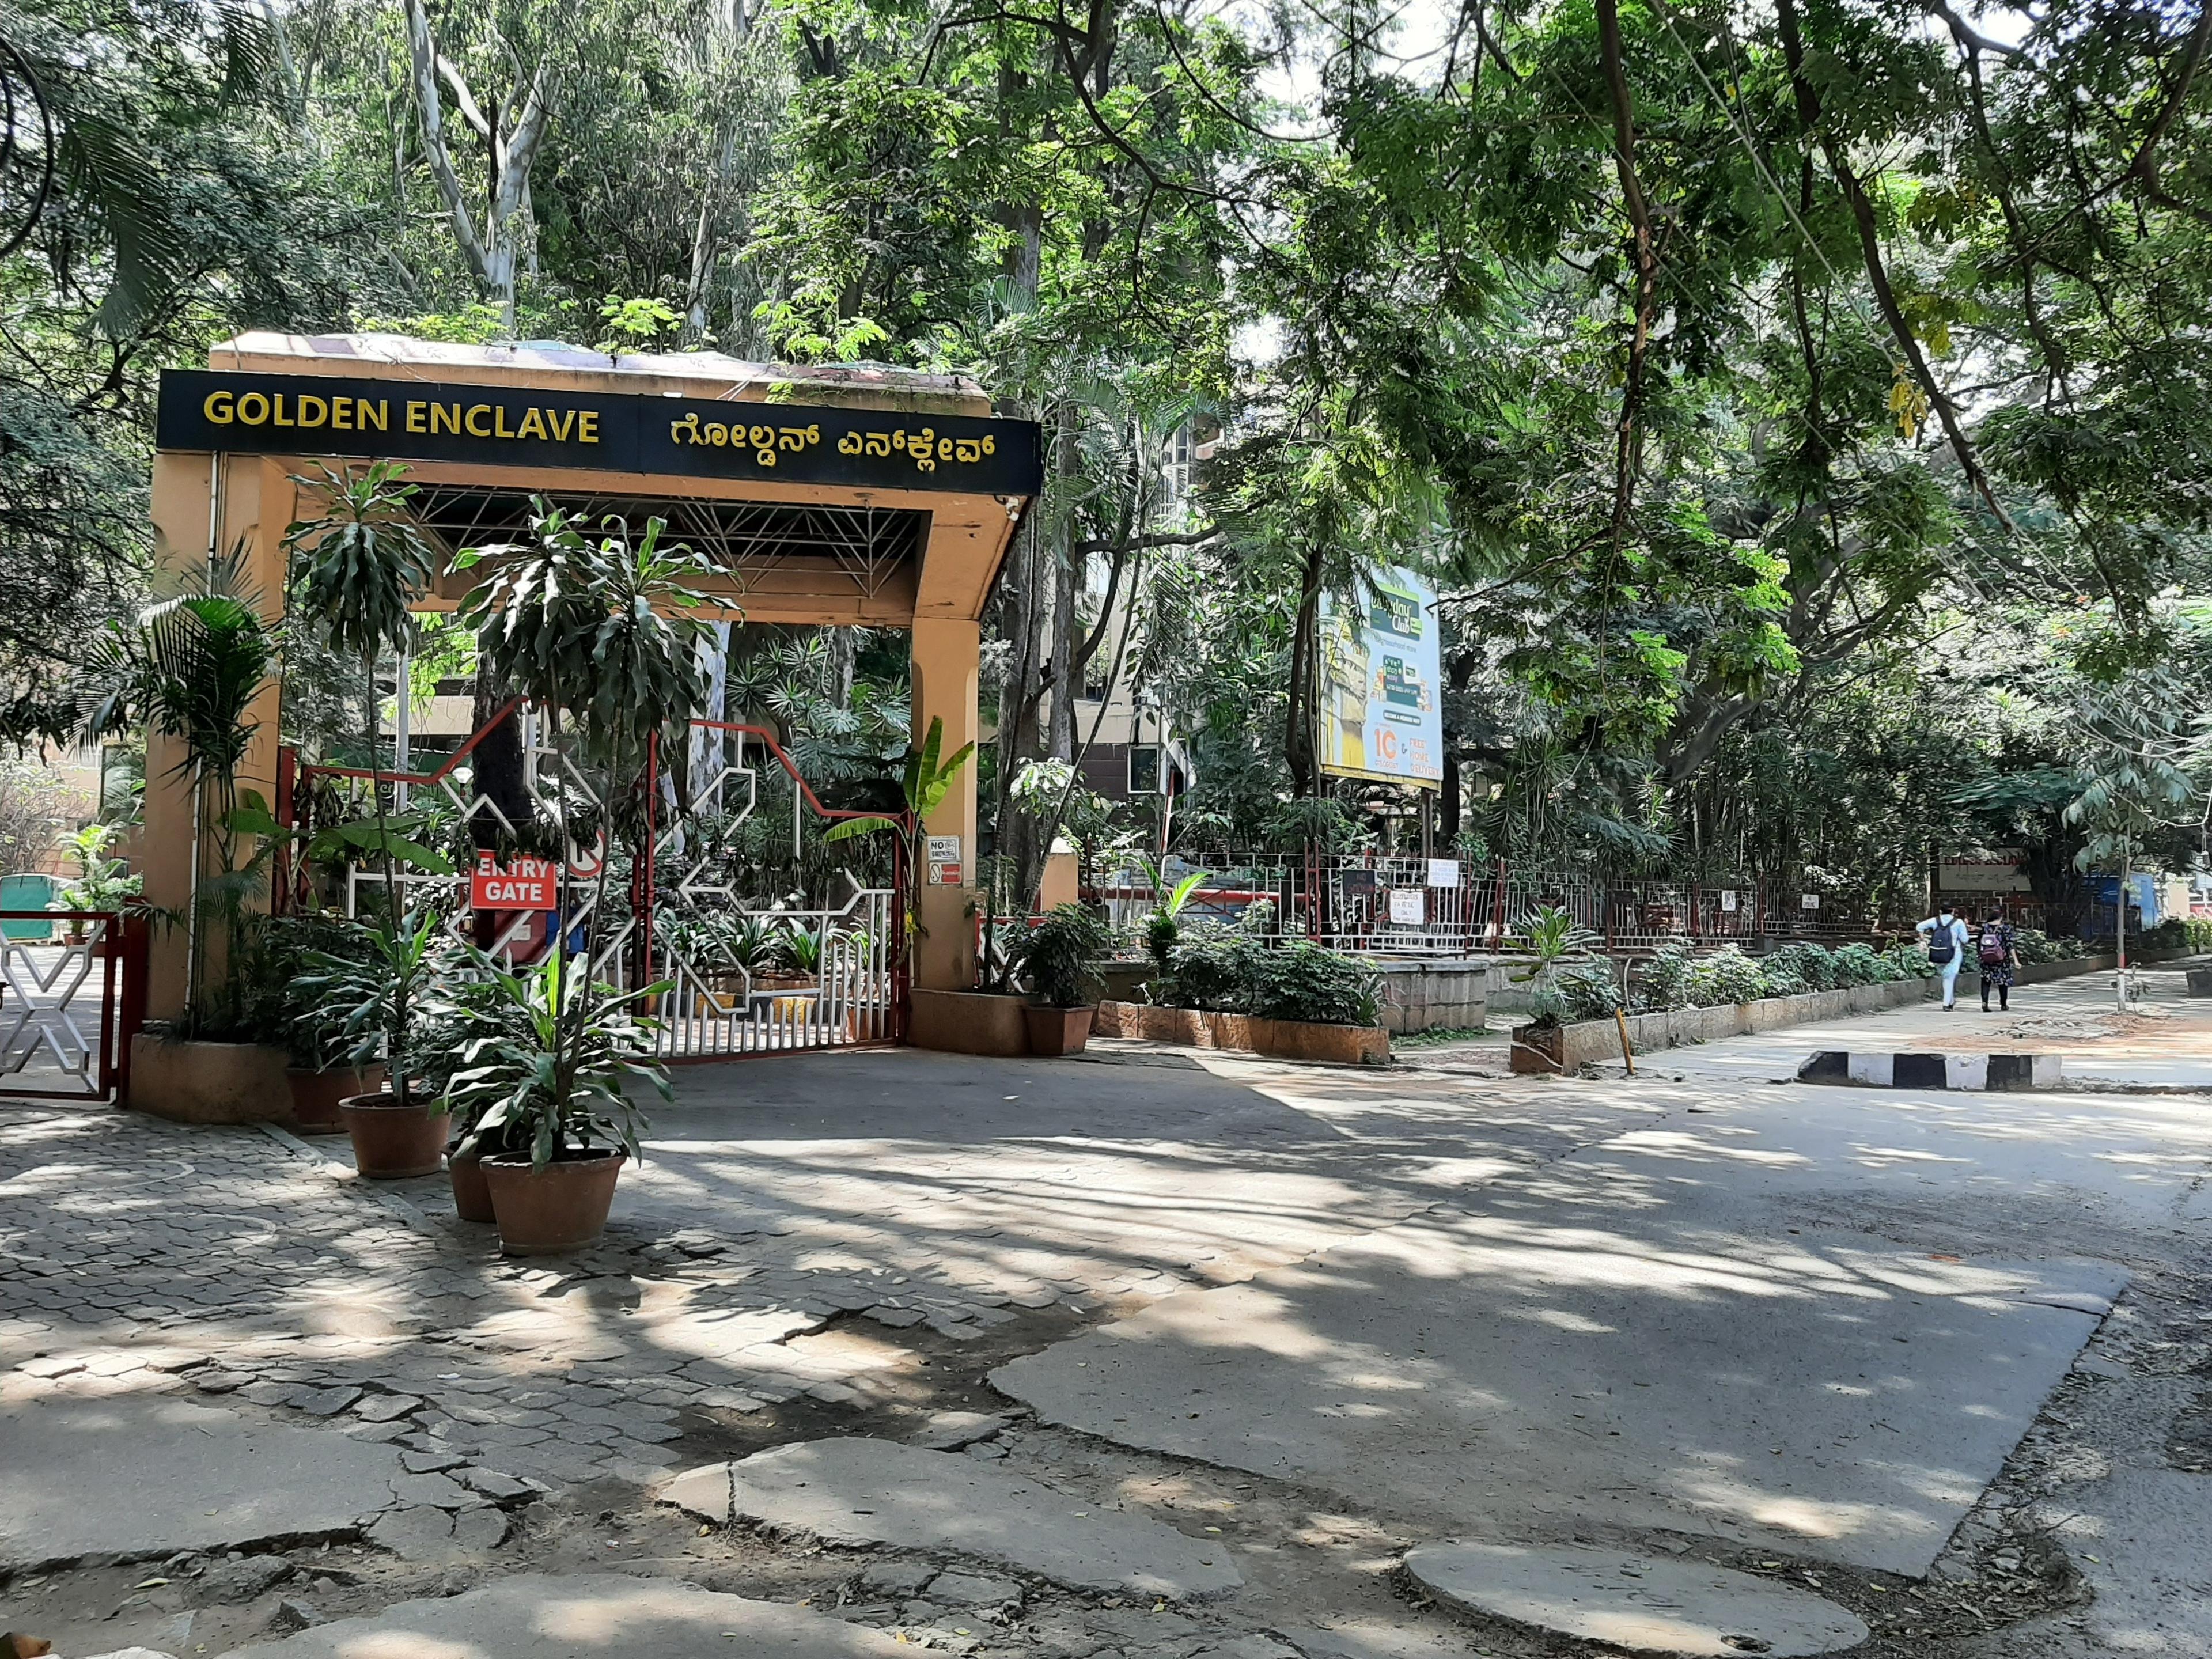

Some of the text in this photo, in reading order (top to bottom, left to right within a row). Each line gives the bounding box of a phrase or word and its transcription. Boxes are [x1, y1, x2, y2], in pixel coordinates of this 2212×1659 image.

[203, 390, 600, 443] GOLDEN ENCLAVE
[670, 412, 820, 467] ಗೋಲ್ಡನ್
[1392, 614, 1410, 634] Club
[931, 842, 944, 850] NO
[485, 881, 543, 902] GATE
